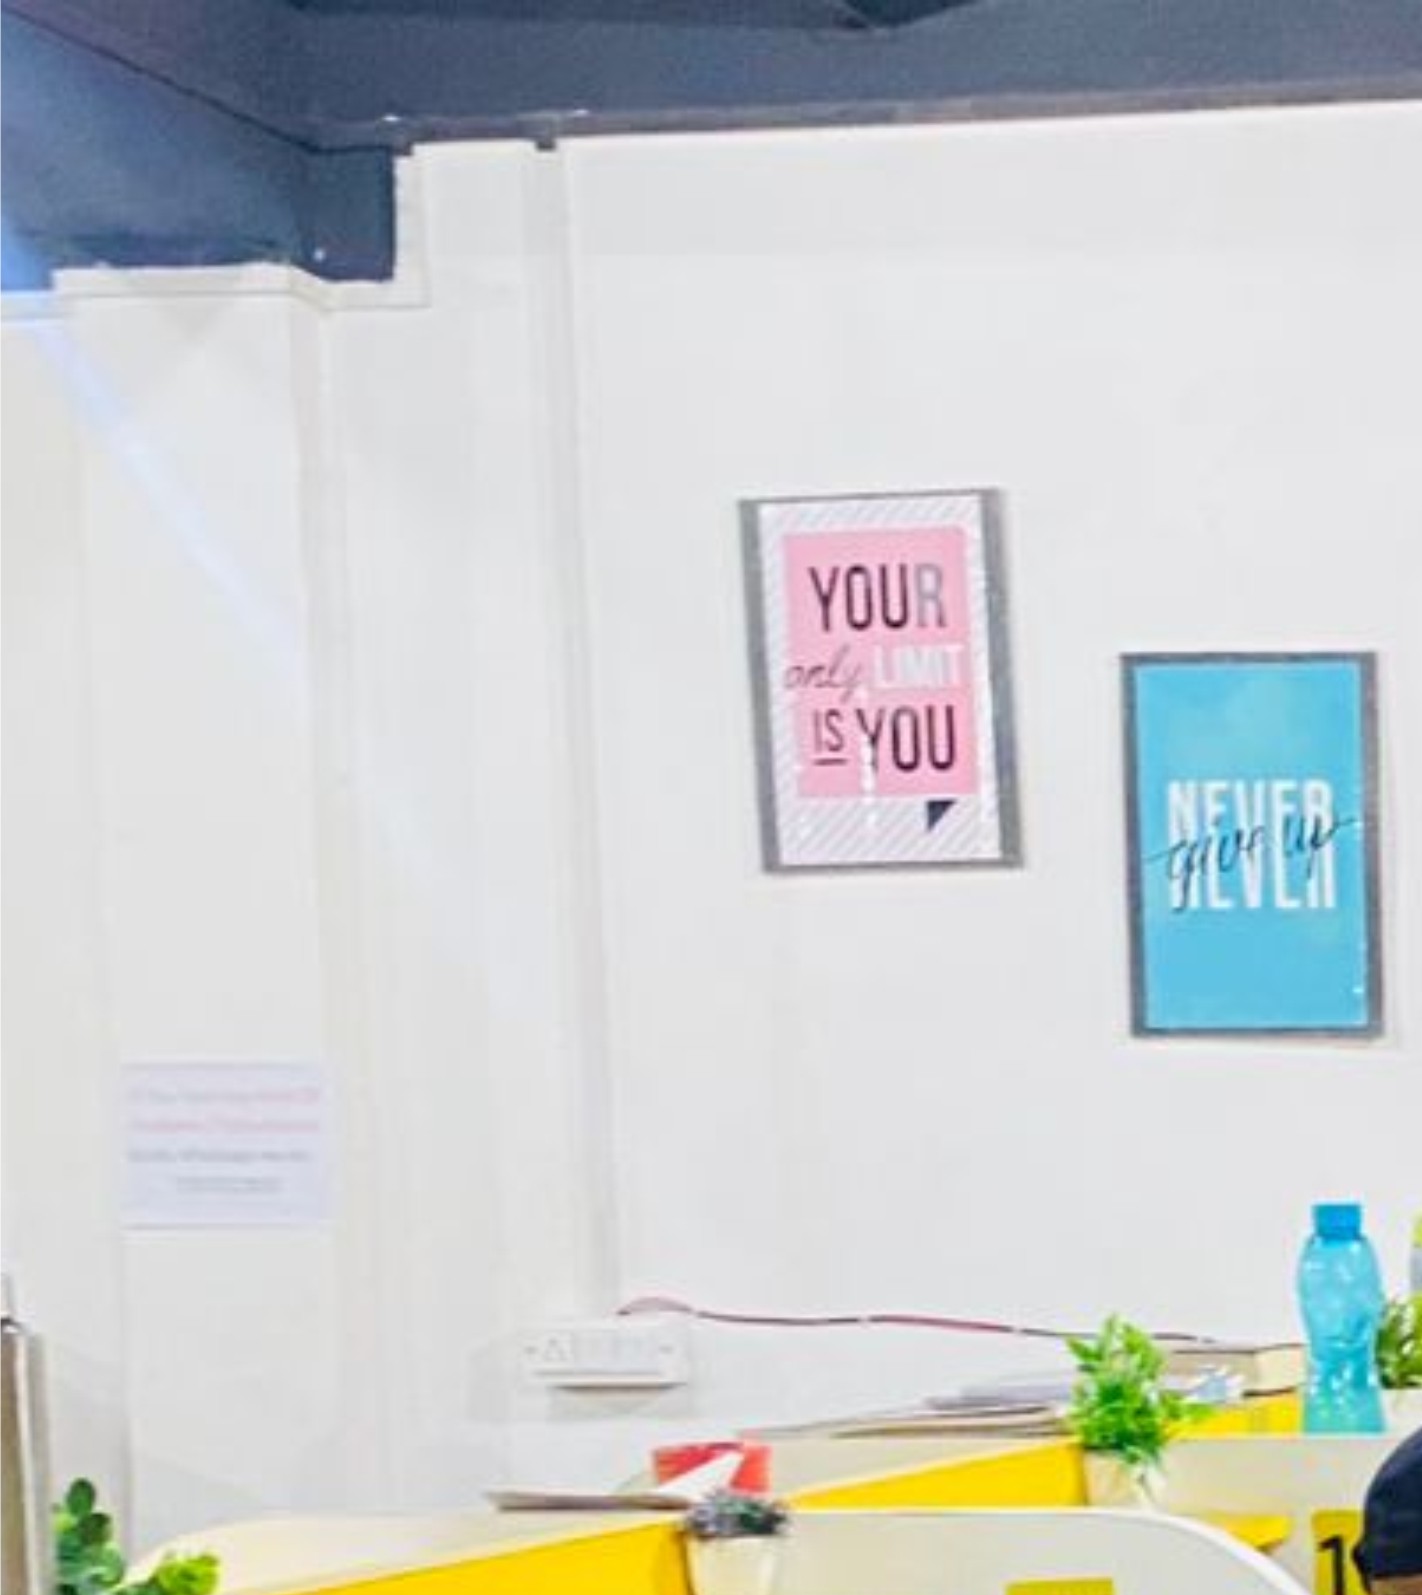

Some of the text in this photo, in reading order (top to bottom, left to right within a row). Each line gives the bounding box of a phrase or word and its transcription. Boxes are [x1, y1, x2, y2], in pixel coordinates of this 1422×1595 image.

[808, 563, 948, 632] YOUR
[812, 703, 957, 775] IS YOU
